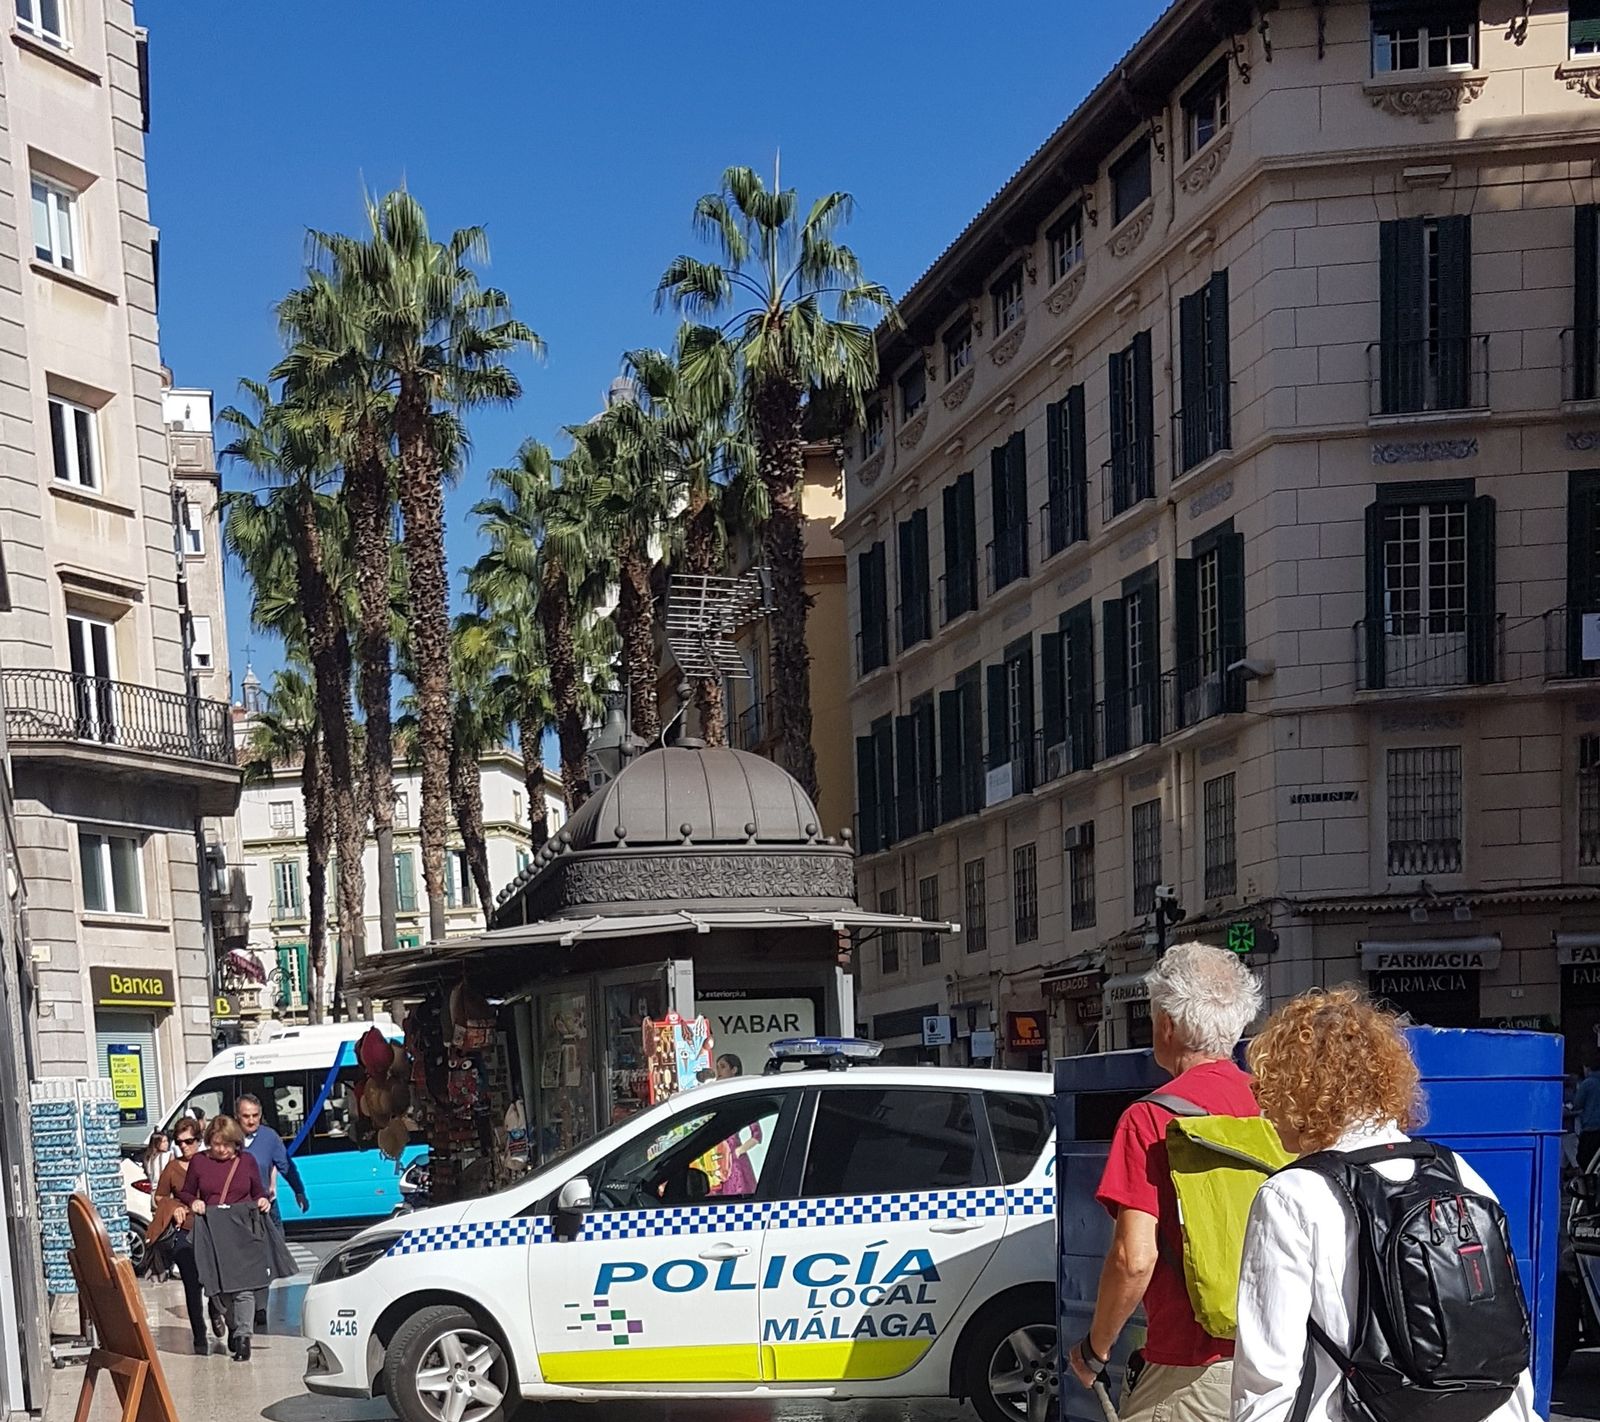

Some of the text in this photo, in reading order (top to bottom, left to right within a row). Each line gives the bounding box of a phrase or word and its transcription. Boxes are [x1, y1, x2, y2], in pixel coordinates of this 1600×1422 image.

[1377, 953, 1484, 968] FARMACIA
[1571, 948, 1600, 962] FA
[110, 974, 164, 995] Bankia
[1051, 976, 1088, 993] TABACOS
[1380, 974, 1467, 993] FARMACIA
[718, 1013, 801, 1035] YABAR
[1012, 1038, 1045, 1046] TABACOS
[593, 1239, 942, 1296] POLICÍA
[807, 1283, 937, 1309] LOCAL
[330, 1319, 358, 1336] 24-16
[762, 1309, 937, 1342] MÁLAGA
